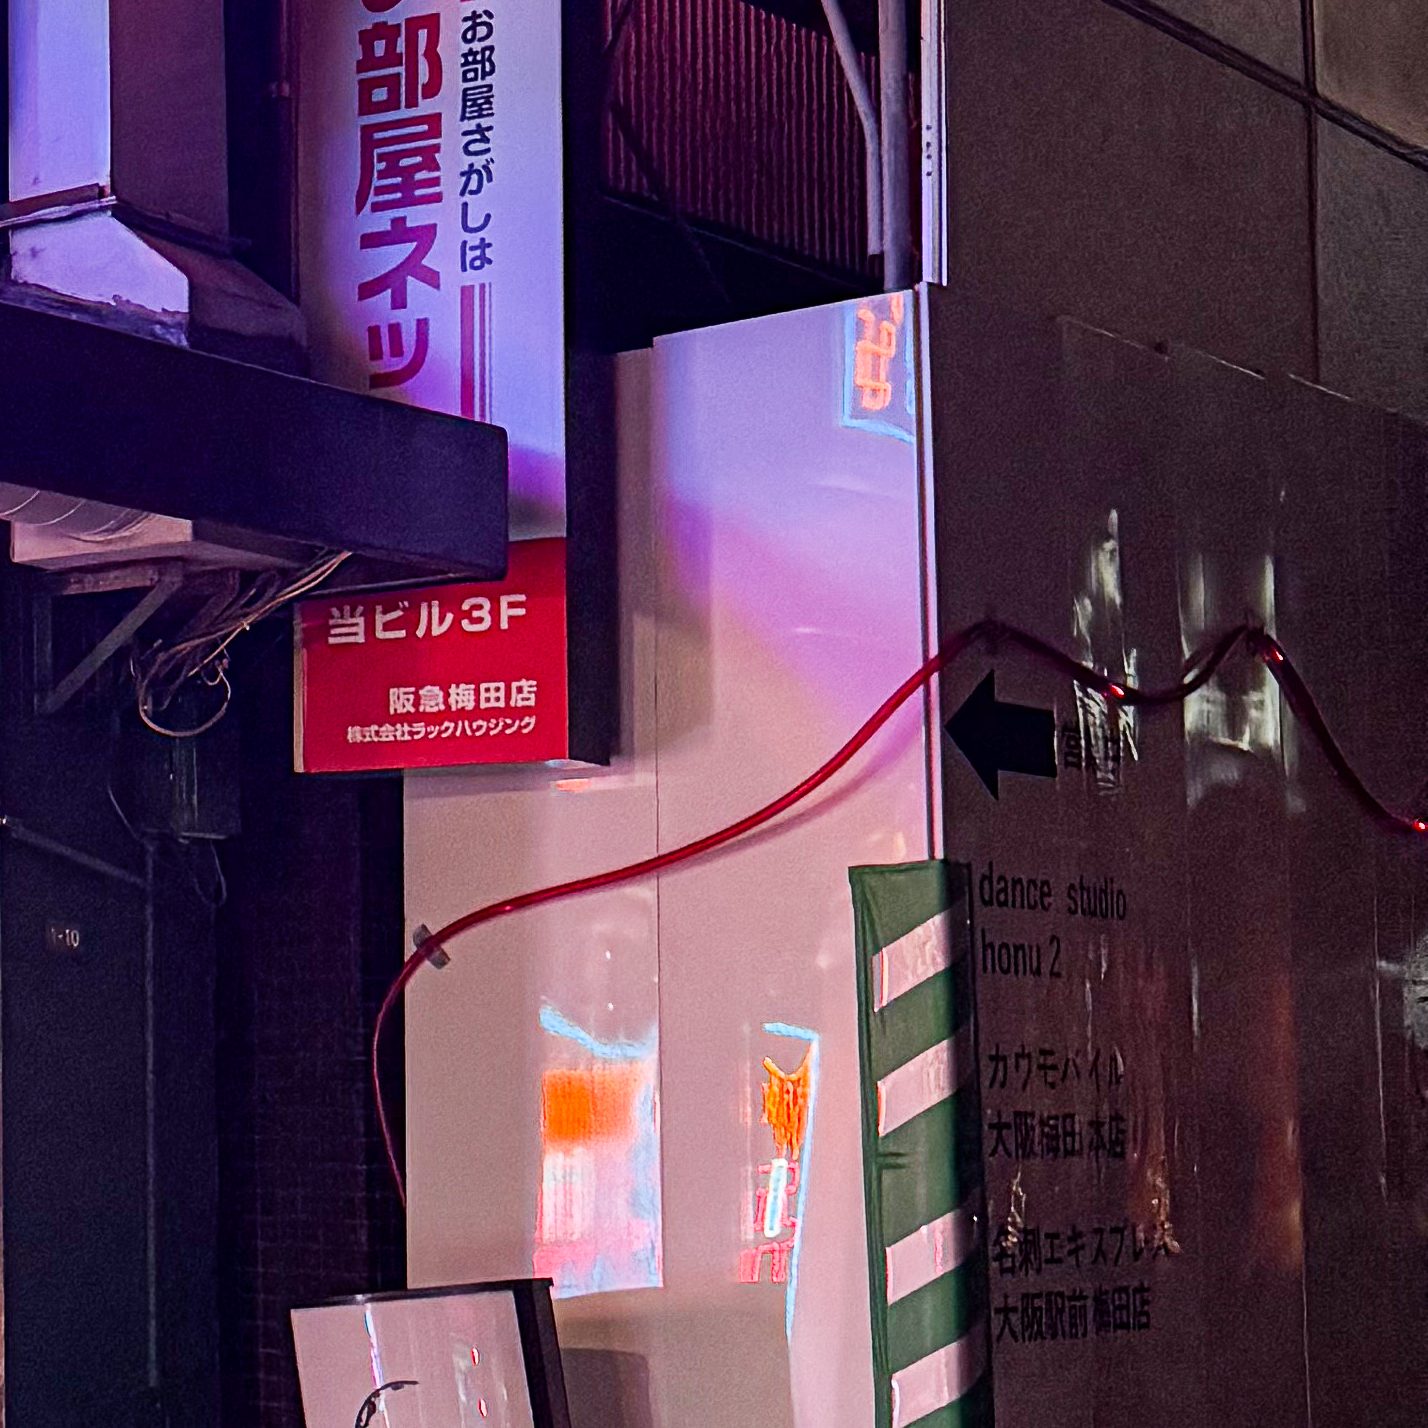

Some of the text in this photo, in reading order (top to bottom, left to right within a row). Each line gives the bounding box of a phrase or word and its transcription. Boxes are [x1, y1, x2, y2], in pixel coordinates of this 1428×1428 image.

[459, 8, 497, 271] お部屋さがしは
[328, 594, 527, 645] 当ビル3F
[389, 678, 538, 715] 阪急梅田店
[347, 715, 537, 744] 株式会社ラックハウジング
[979, 861, 1127, 921] dance studio
[981, 927, 1062, 978] honu 2
